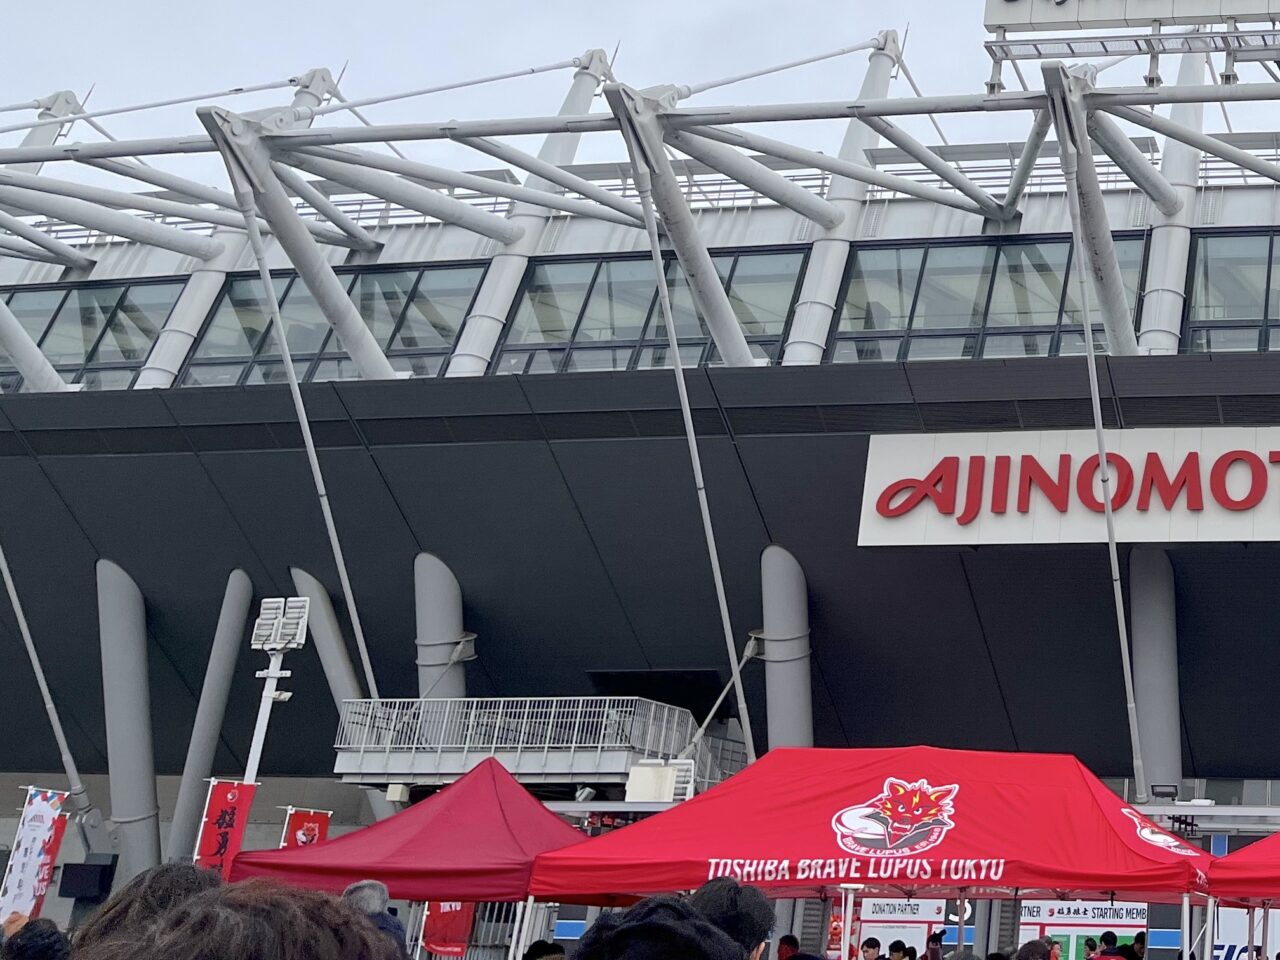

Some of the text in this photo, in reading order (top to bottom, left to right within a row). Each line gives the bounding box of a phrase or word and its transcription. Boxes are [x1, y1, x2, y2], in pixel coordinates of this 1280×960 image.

[708, 858, 790, 882] TOSHIBA
[796, 858, 861, 880] BRAVE
[868, 858, 934, 880] LUPUS
[872, 903, 920, 915] DONATION PARTNER
[1091, 907, 1124, 919] STARTING
